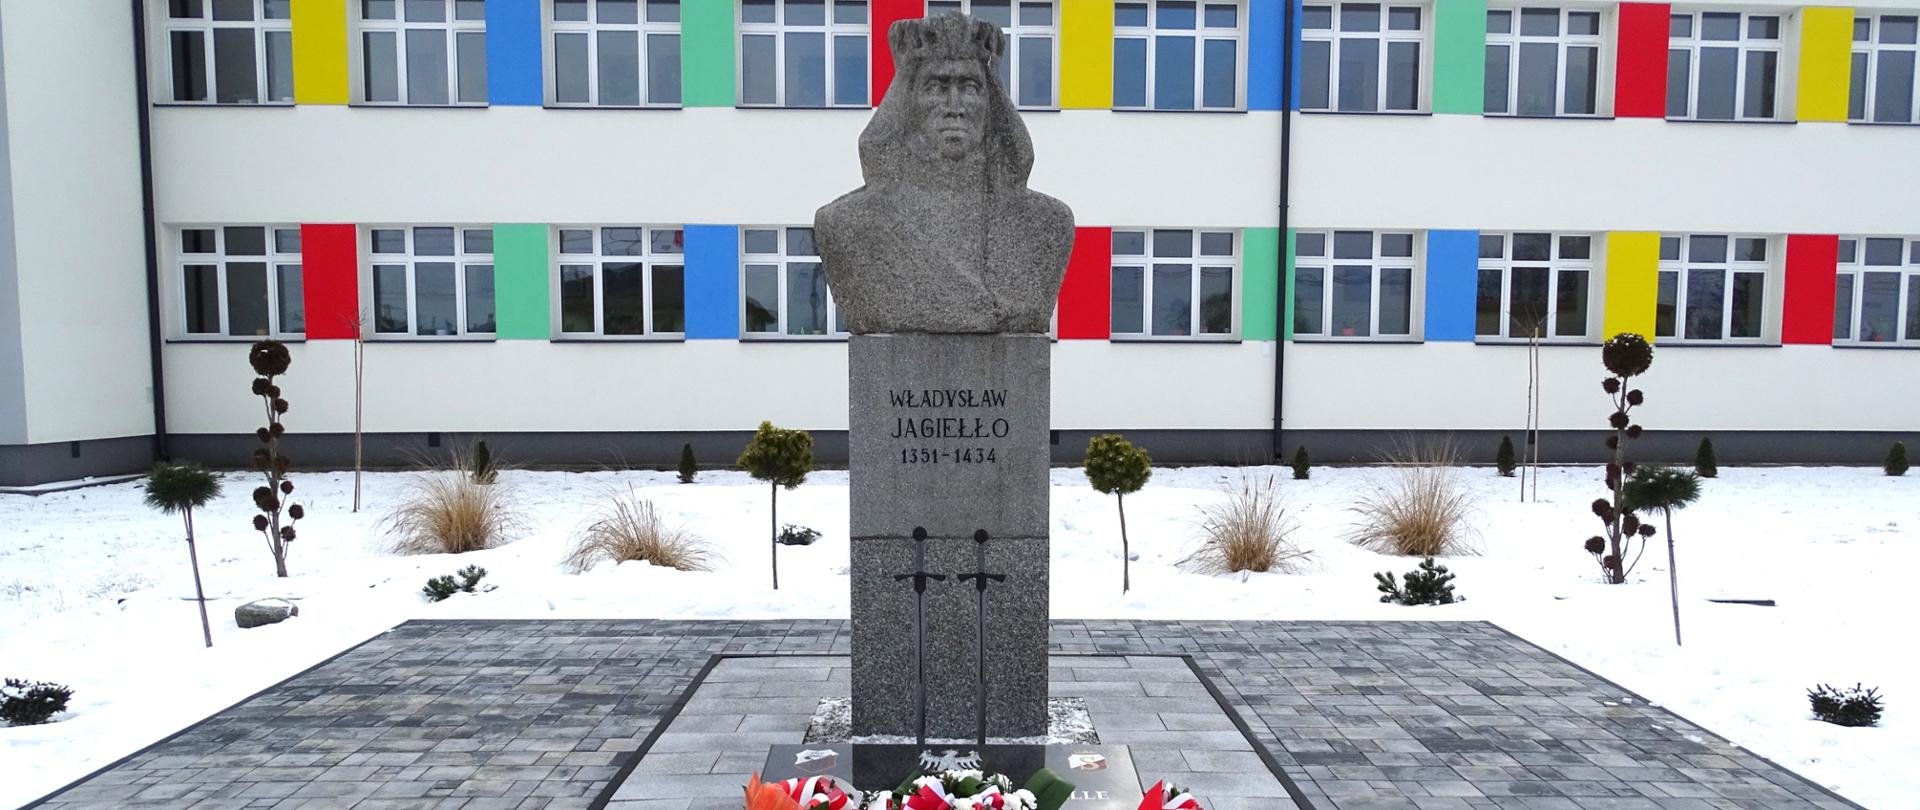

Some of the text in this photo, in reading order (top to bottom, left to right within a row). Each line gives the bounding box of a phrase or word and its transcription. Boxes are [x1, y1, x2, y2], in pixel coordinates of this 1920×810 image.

[889, 389, 1008, 408] WŁADYSŁAW
[890, 418, 1010, 439] JAGIEŁŁO
[901, 448, 997, 464] 1351-1434
[1070, 790, 1110, 800] LLE
